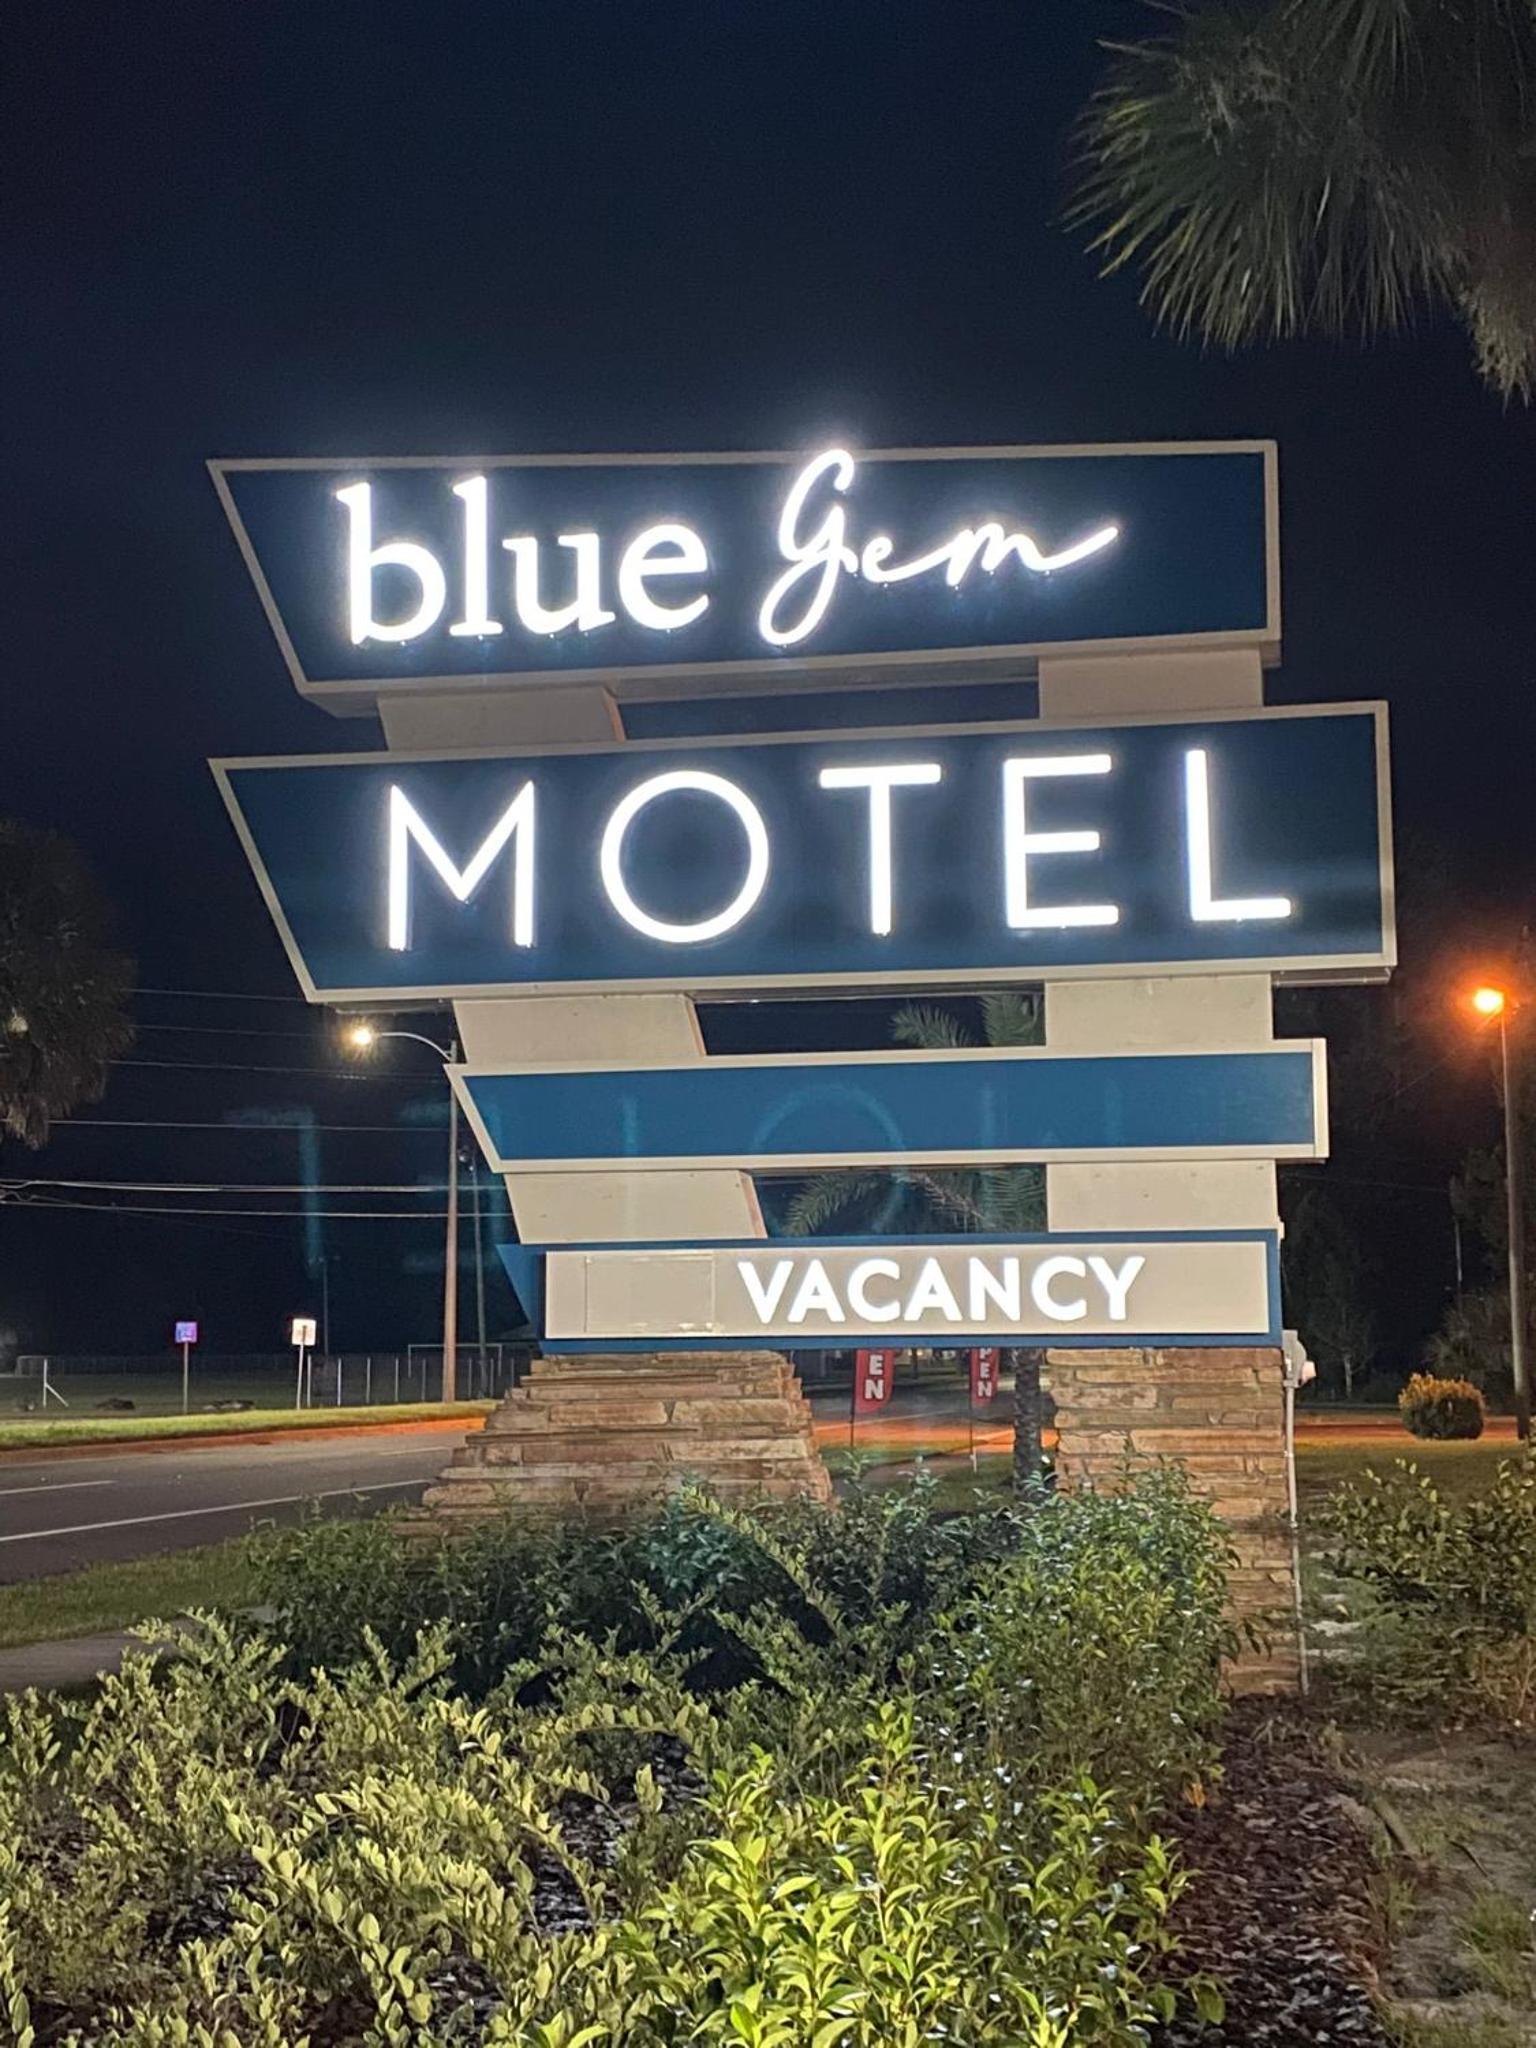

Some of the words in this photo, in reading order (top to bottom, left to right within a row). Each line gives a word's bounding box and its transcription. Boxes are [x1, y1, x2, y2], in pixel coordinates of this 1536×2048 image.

[336, 475, 709, 645] blue
[759, 447, 1119, 647] Gem
[388, 749, 1292, 951] MOTEL
[737, 1255, 1146, 1324] VACANCY
